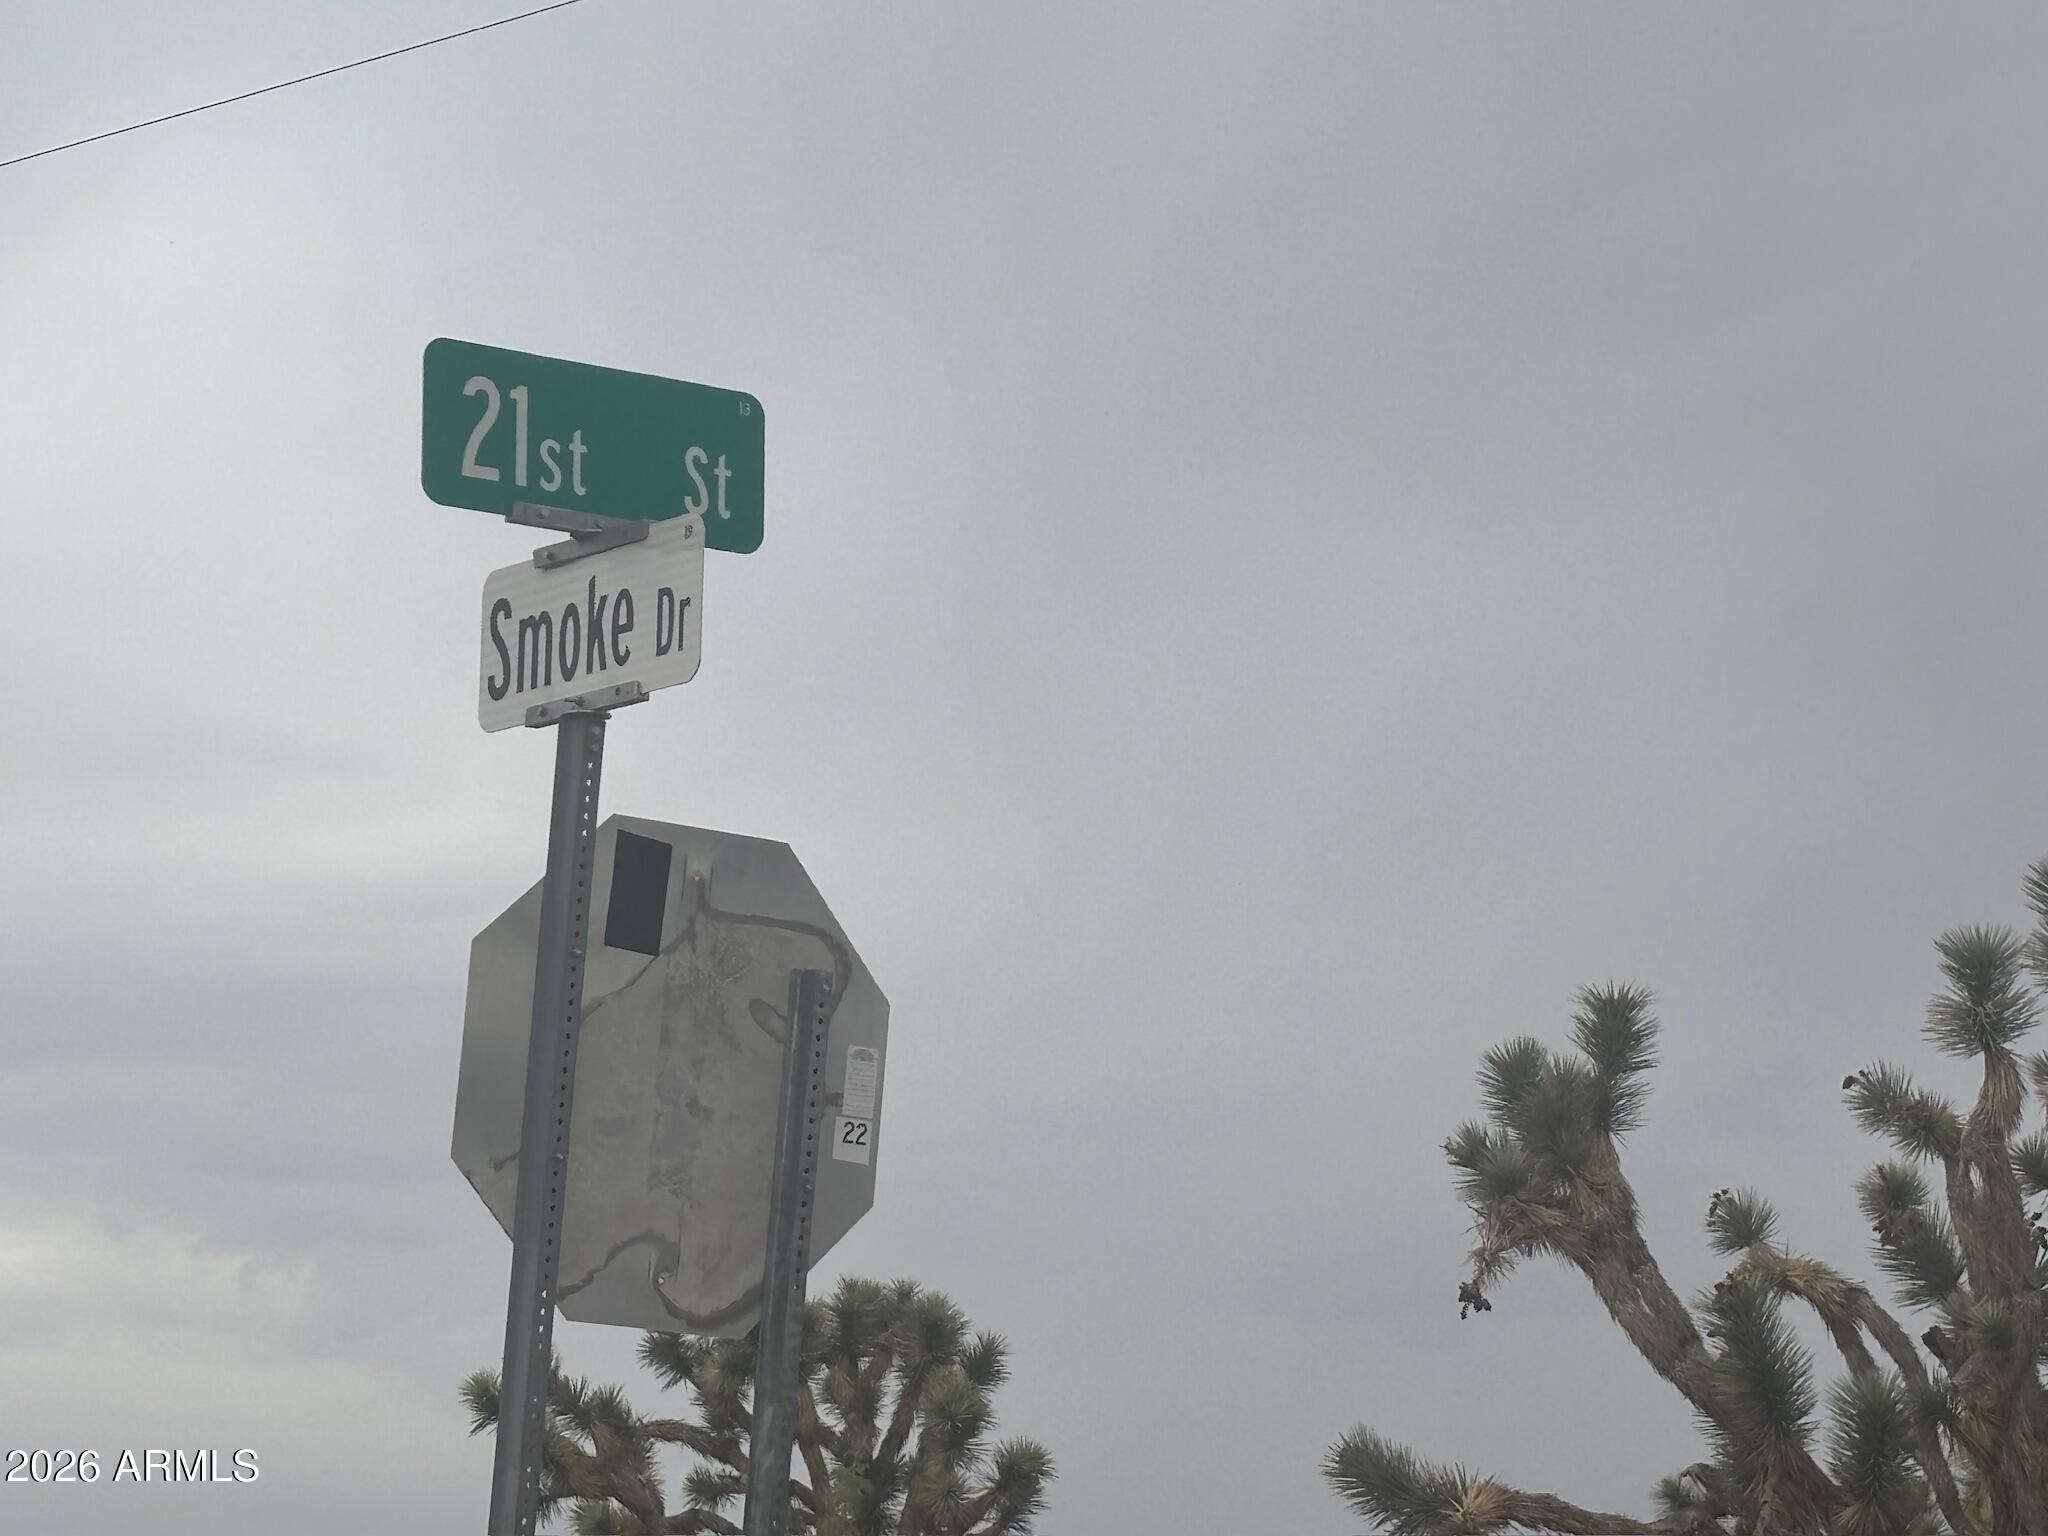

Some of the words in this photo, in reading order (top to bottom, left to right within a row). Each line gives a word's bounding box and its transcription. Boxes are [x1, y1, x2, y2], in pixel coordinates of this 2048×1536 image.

[461, 375, 588, 497] 21st
[683, 446, 732, 520] St
[487, 575, 634, 701] Smoke
[655, 586, 691, 657] Dr
[842, 1121, 868, 1146] 22
